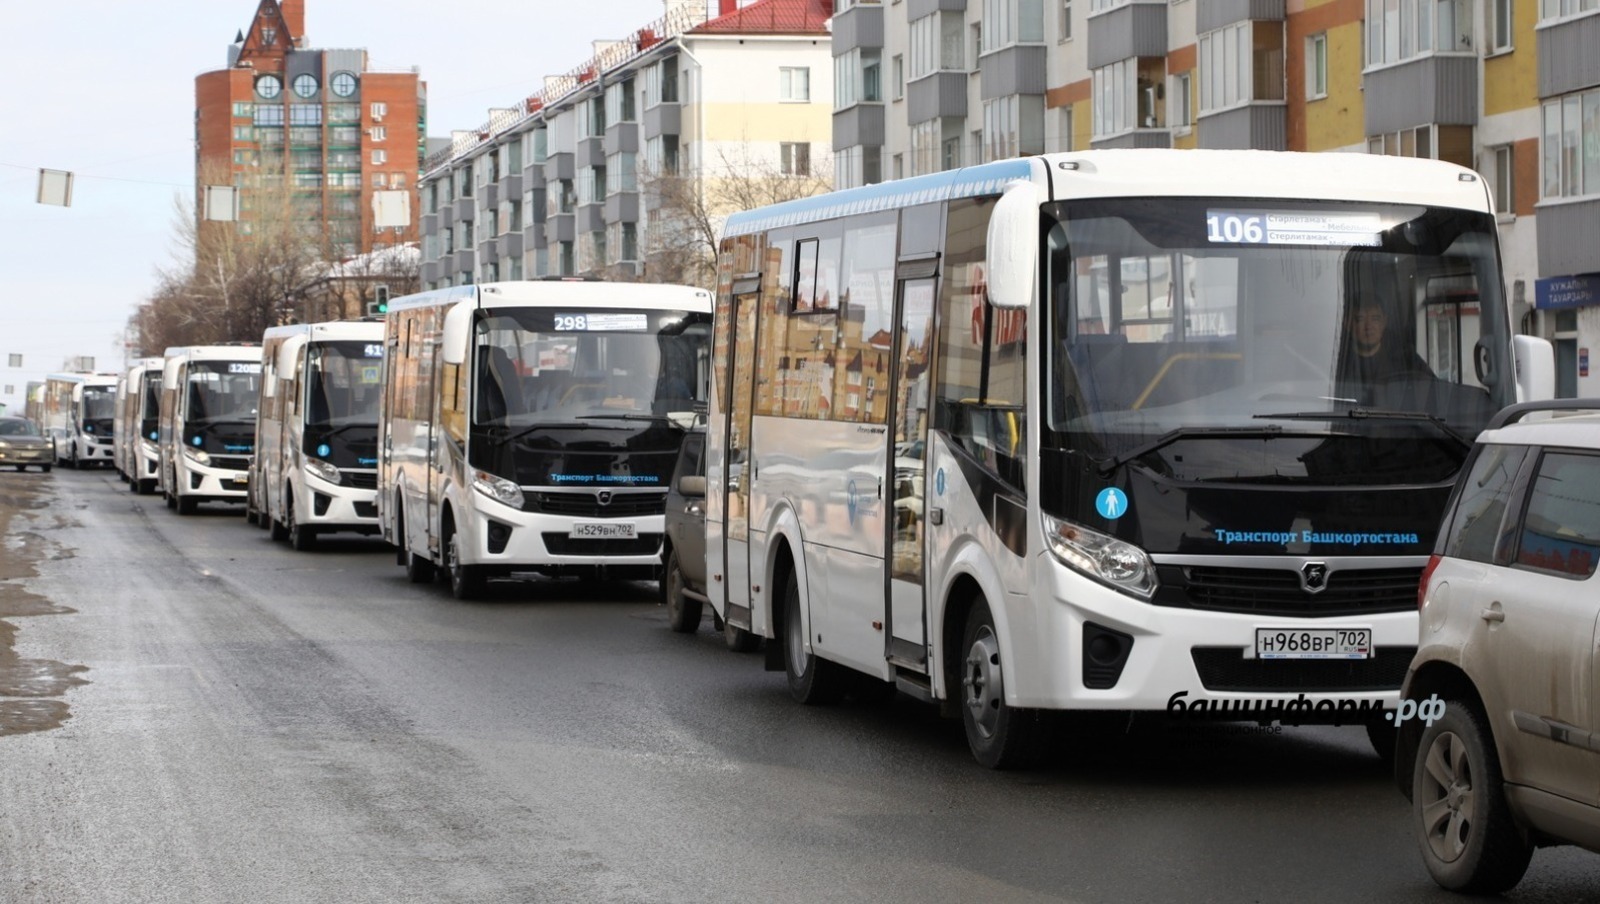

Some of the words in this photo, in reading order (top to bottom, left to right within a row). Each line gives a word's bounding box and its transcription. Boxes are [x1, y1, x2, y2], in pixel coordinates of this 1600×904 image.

[1207, 216, 1263, 243] 106
[1269, 232, 1328, 241] Стерлитамак
[555, 316, 586, 331] 298
[230, 363, 249, 373] 120
[551, 474, 594, 482] Транспорт
[596, 474, 659, 482] Башкортостана
[577, 525, 616, 536] Н529ВН
[617, 524, 632, 534] 702
[1215, 529, 1298, 545] Транспорт
[1302, 530, 1419, 545] Башкортостана
[1263, 632, 1335, 652] Н968ВР
[1339, 631, 1366, 646] 702
